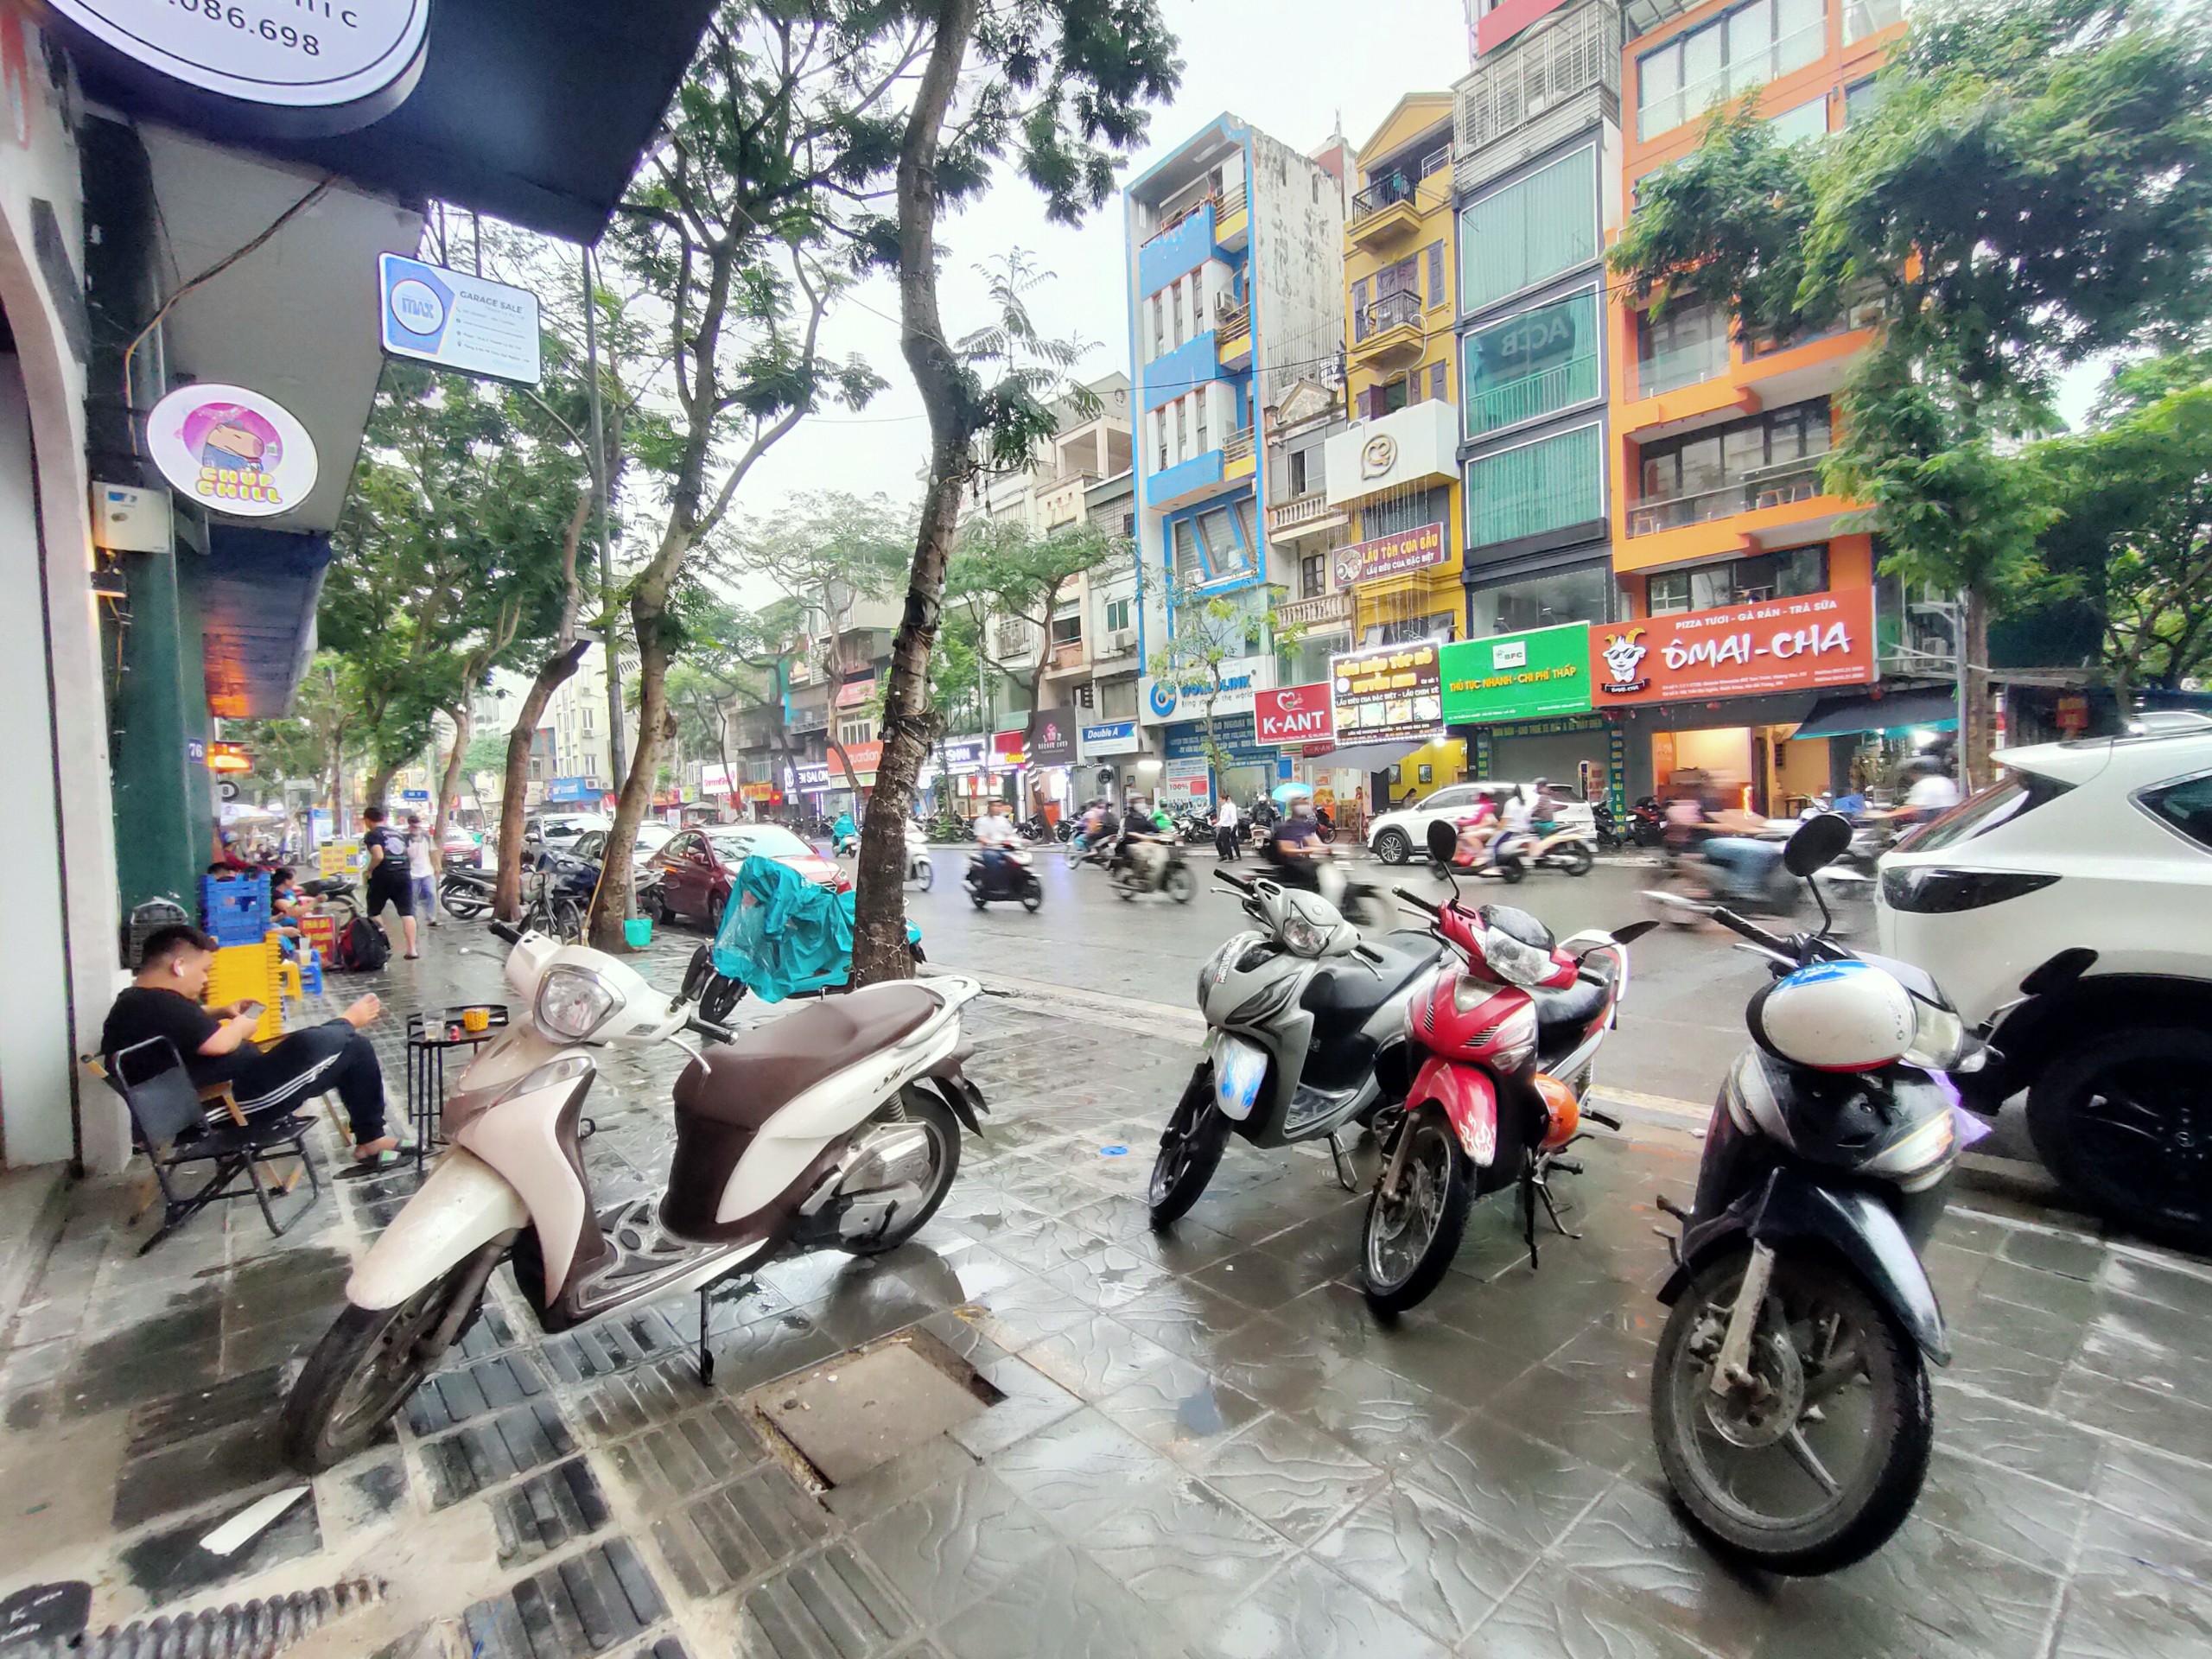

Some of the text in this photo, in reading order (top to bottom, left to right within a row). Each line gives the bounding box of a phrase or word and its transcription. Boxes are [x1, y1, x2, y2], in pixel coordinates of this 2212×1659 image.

[460, 290, 498, 307] GARAGE
[500, 300, 523, 314] SALE
[196, 480, 283, 504] CHILL
[1401, 539, 1417, 555] CUA
[1392, 560, 1406, 569] CUA
[1675, 619, 1702, 630] PIZZA
[1704, 615, 1729, 626] TƯƠI
[1738, 611, 1754, 623] GÀ
[1758, 607, 1780, 620] RÁN
[1789, 601, 1810, 614] TRÀ
[1814, 599, 1837, 612] SỮA
[1504, 652, 1522, 660] BFC
[1179, 674, 1252, 698] WORLLINK
[1450, 678, 1464, 692] THỦ
[1465, 679, 1481, 692] TỤC
[1483, 675, 1512, 688] NHANH
[1517, 673, 1534, 683] CHI
[1535, 667, 1551, 681] PHÍ
[1553, 663, 1577, 679] THẤP
[1181, 699, 1196, 708] Bring
[1236, 690, 1253, 699] world
[1262, 710, 1325, 734] K-ANT
[1087, 727, 1119, 740] Double A
[189, 743, 203, 758] 76
[1314, 744, 1335, 753] K-ANT
[848, 749, 879, 766] guardian
